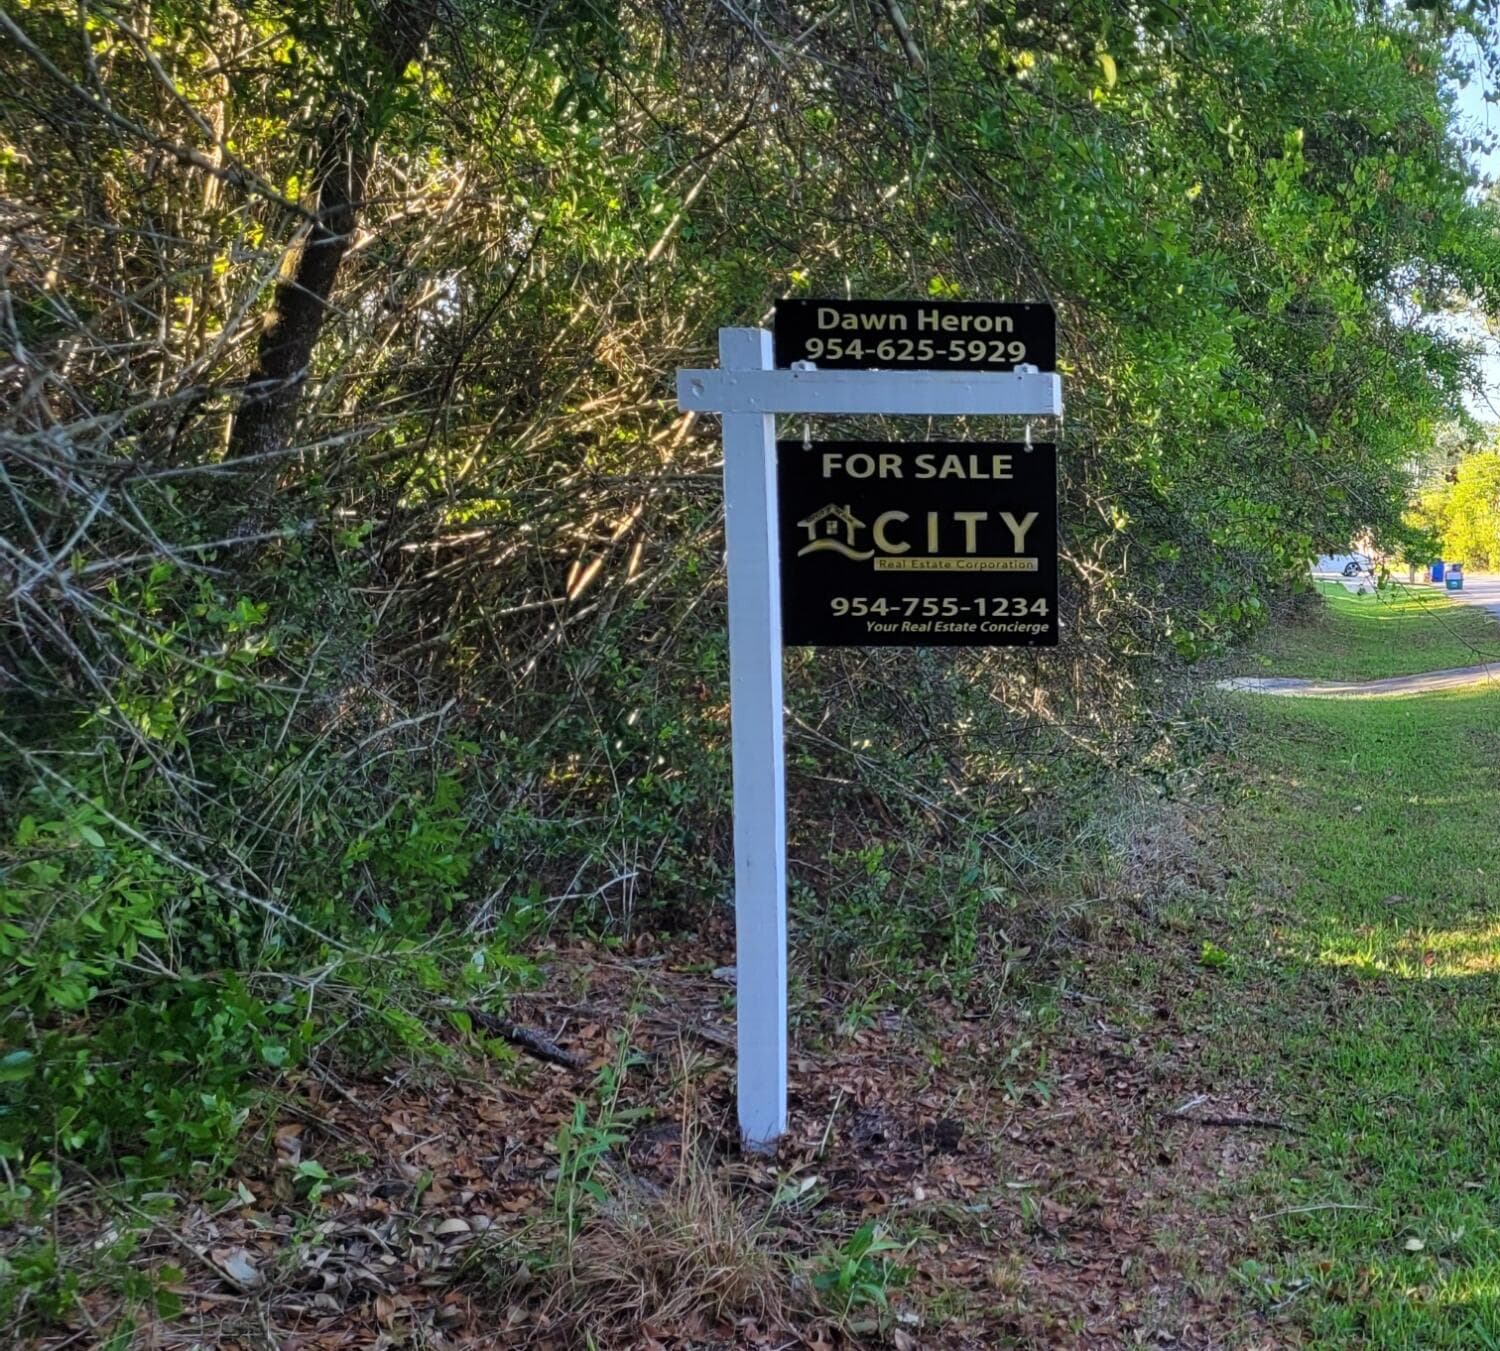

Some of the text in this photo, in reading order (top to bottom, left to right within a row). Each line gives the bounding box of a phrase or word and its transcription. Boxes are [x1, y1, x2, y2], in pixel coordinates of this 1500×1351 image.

[817, 308, 1014, 332] Dawn Heron
[804, 338, 1026, 362] 954-625-5929
[822, 454, 1013, 478] FOR SALE
[873, 510, 1039, 553] CITY
[878, 560, 1034, 572] Real Estate Corporation
[830, 597, 1049, 616] 954-755-1234
[866, 621, 1049, 635] Your Real Estate Concierge
